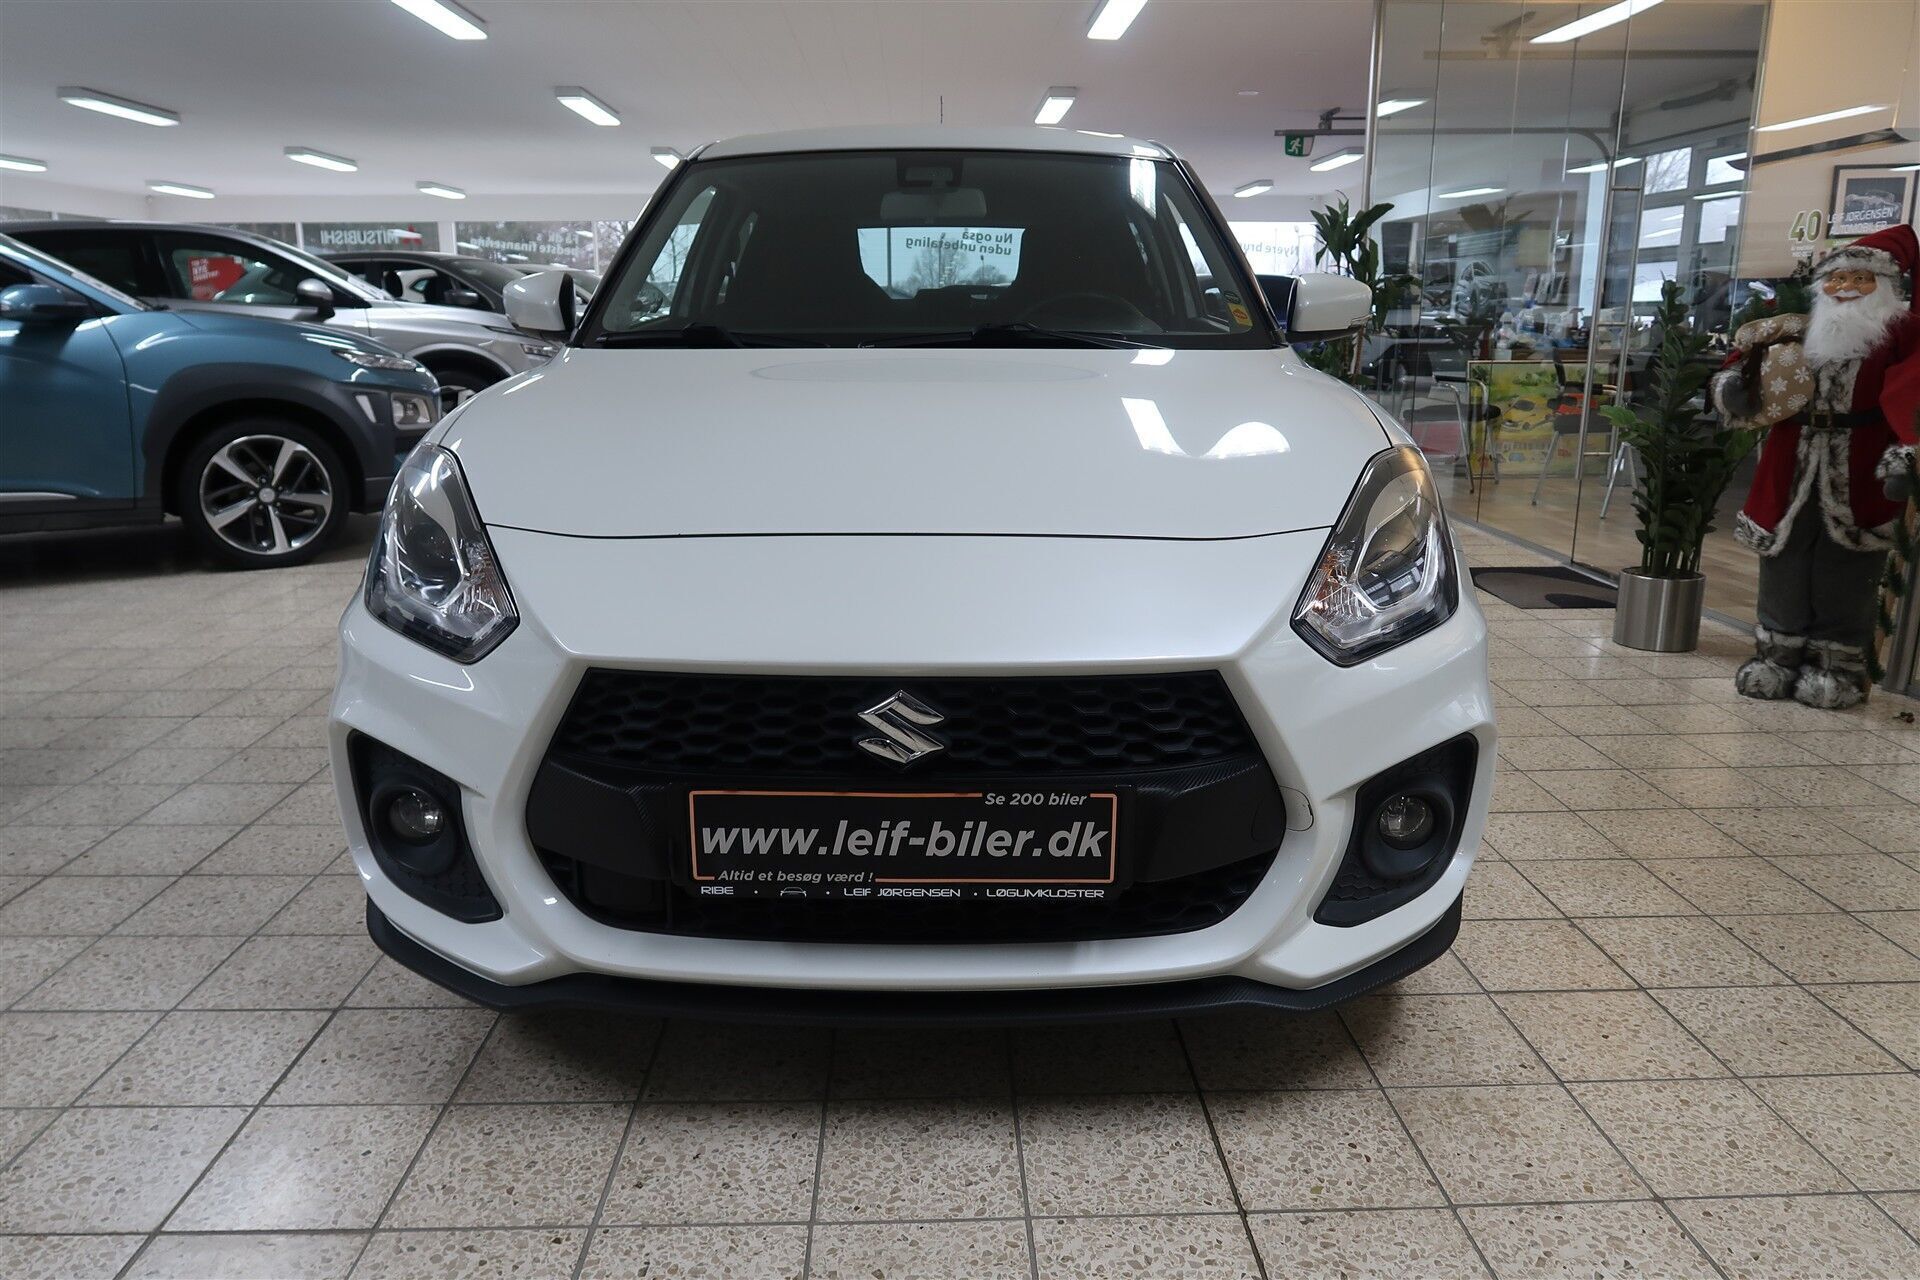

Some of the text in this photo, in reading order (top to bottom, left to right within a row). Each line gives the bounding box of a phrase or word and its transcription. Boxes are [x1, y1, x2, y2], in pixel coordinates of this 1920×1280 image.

[1788, 209, 1822, 242] 40
[984, 793, 1087, 806] Se 200 biler
[702, 820, 1109, 857] www.leif-biler.dk
[718, 870, 754, 882] Altid
[758, 871, 773, 882] et
[777, 870, 821, 884] besøg
[826, 871, 865, 883] værd
[701, 886, 1105, 898] RIBE LEIF JØRGENSEN LØGUMKLOSTER
